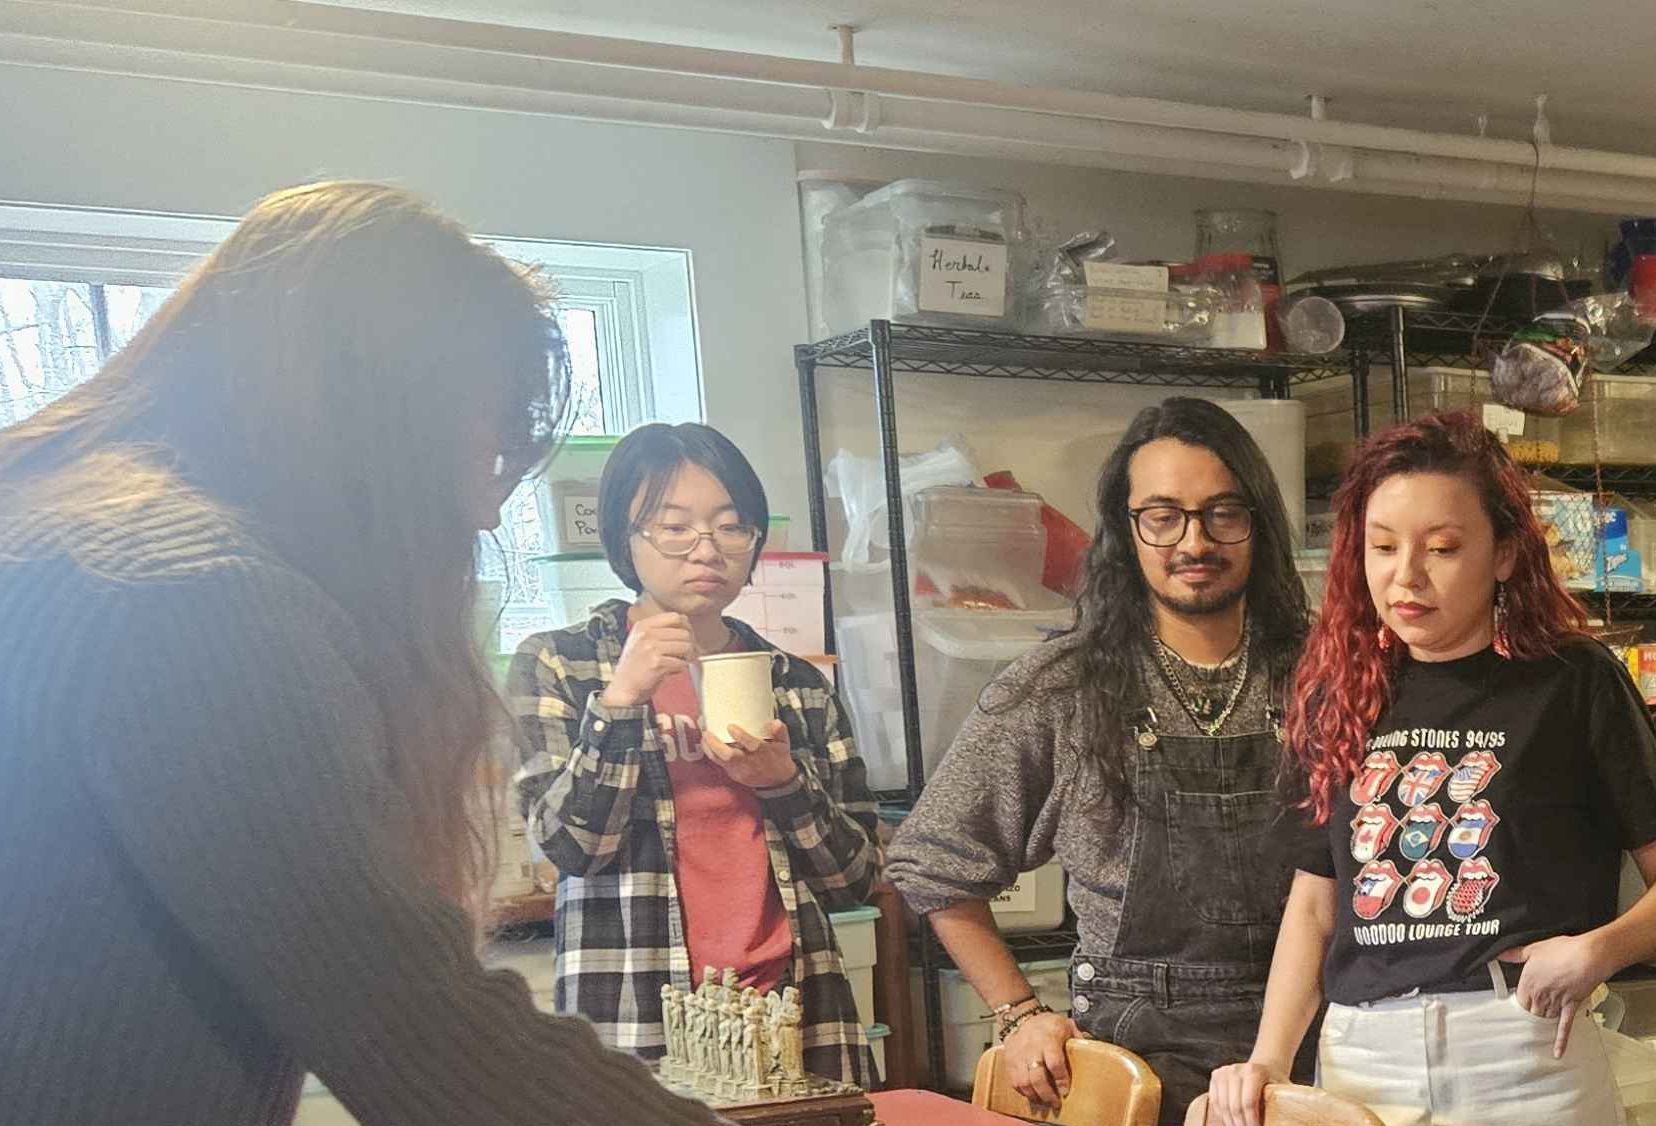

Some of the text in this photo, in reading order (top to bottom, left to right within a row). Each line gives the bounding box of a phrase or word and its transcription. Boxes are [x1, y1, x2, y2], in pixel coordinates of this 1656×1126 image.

[1410, 728, 1460, 749] STONES
[1466, 730, 1506, 749] 94/95
[1353, 919, 1500, 946] VOODOO LOUNGE TOUR
